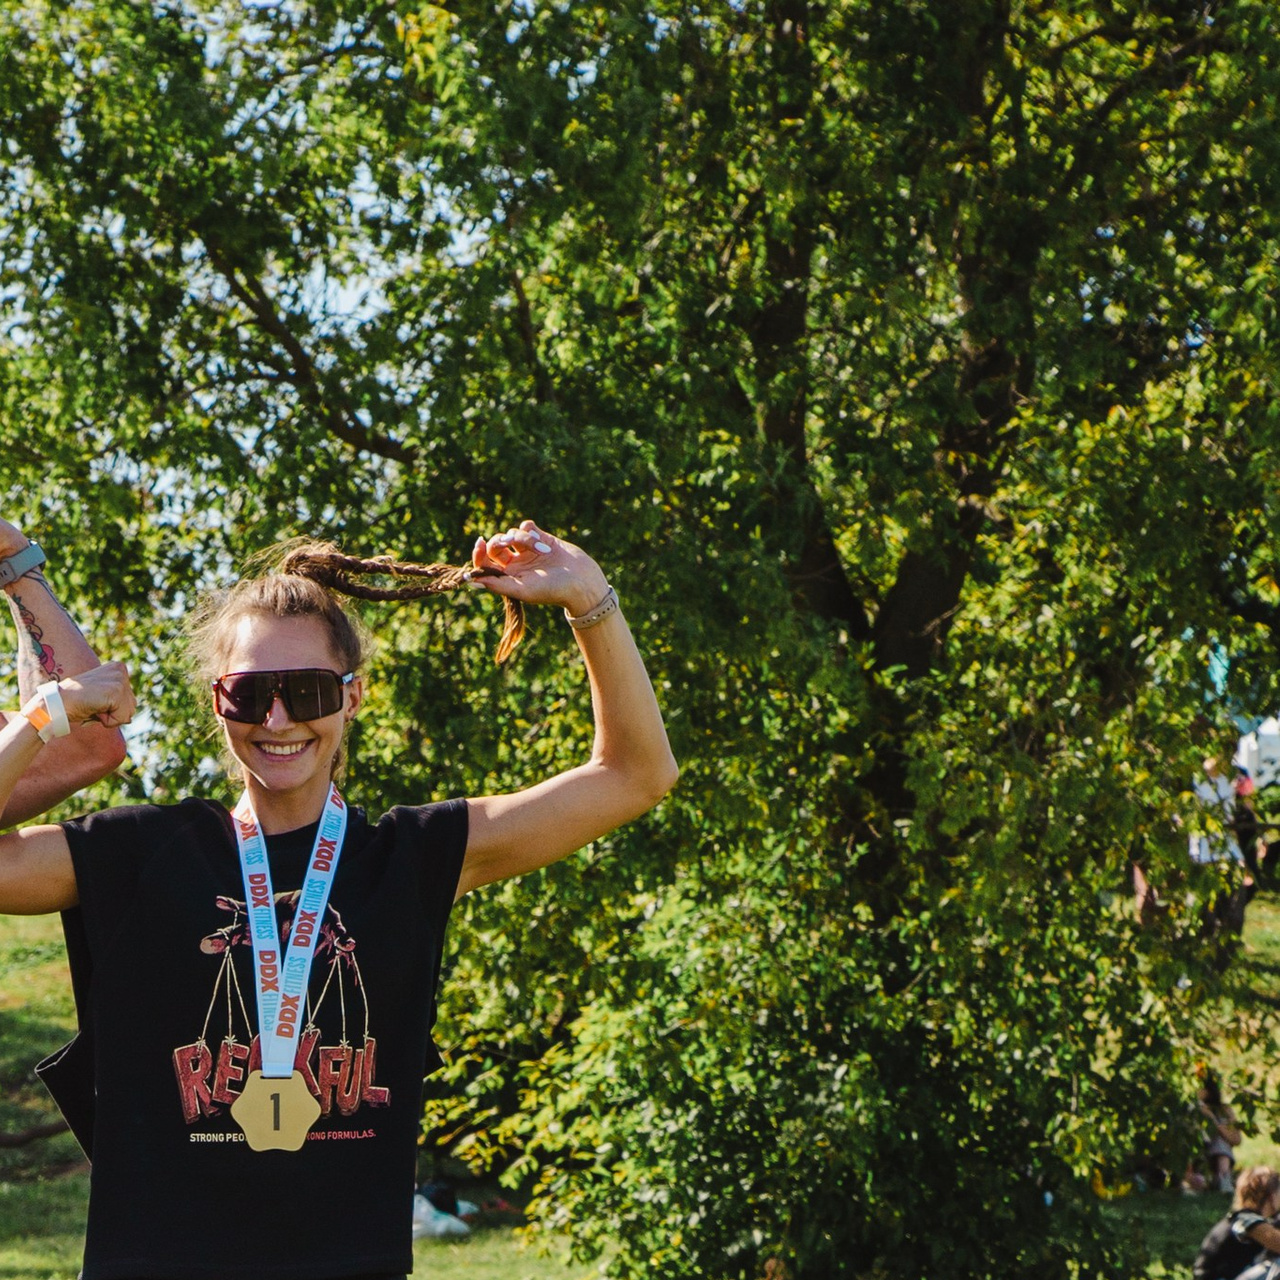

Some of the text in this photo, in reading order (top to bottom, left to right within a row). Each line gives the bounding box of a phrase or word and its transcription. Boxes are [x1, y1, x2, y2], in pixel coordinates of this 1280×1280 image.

[312, 836, 338, 873] DDX
[249, 873, 270, 908] DDX
[301, 879, 326, 911] FITNESS
[253, 908, 274, 940] FITNESS
[293, 910, 318, 947] DDX
[259, 950, 279, 993] DDX
[283, 956, 306, 995] FITNESS
[276, 993, 300, 1038] DDX
[270, 1093, 280, 1131] 1
[189, 1133, 225, 1142] STRONG
[327, 1129, 376, 1140] FORMULAS.
